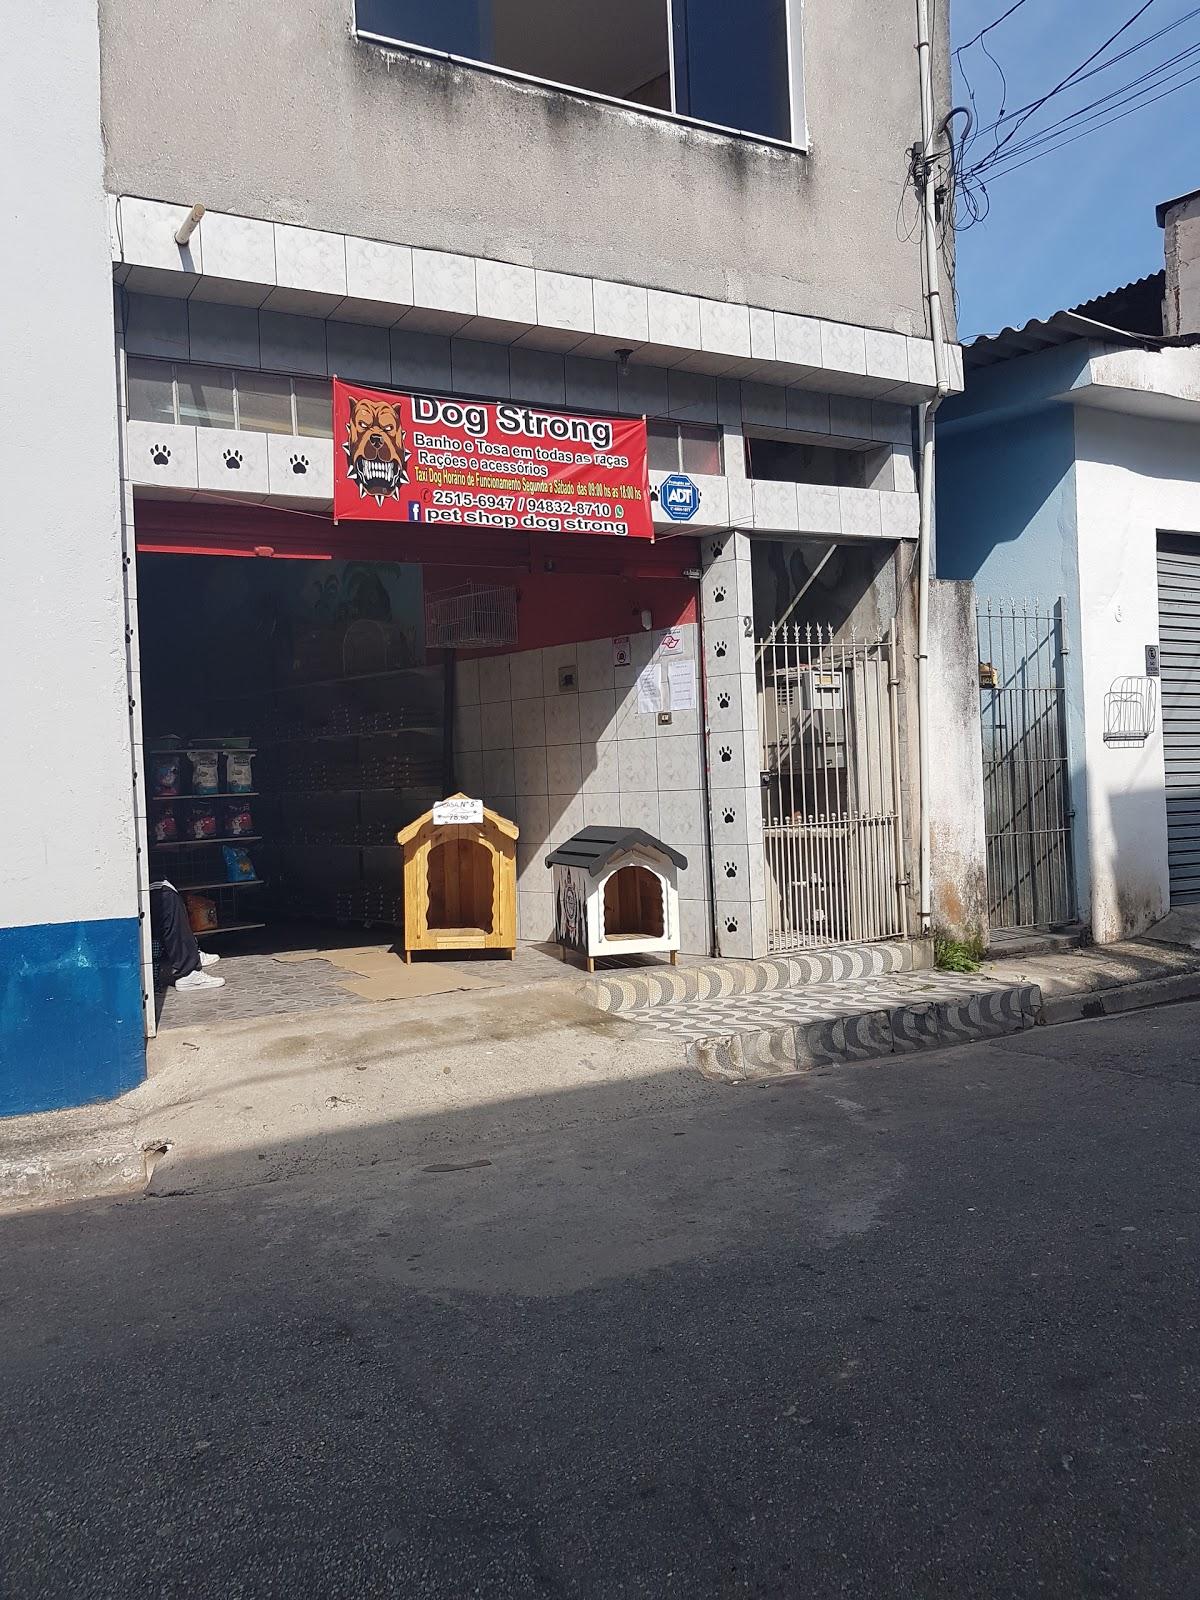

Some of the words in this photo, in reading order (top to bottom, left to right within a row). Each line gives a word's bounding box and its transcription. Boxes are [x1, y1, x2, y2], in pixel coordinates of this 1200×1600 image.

[412, 395, 487, 436] Dog
[498, 404, 612, 449] Strong
[415, 433, 461, 450] Banho
[465, 442, 473, 451] e
[477, 440, 508, 455] Tosa
[512, 447, 532, 458] em
[536, 448, 572, 462] todas
[576, 454, 591, 462] as
[595, 455, 628, 468] raças
[419, 451, 466, 468] Rações
[470, 460, 478, 468] e
[481, 460, 547, 475] acessórios
[415, 466, 427, 482] Taxi
[429, 469, 442, 486] Dog
[443, 470, 465, 485] Horário
[467, 474, 474, 486] de
[476, 474, 521, 490] Funcionamento
[522, 478, 547, 494] Segunda
[549, 485, 553, 493] a
[553, 480, 574, 495] Sábado
[577, 484, 587, 496] das
[603, 485, 611, 497] hs
[612, 489, 618, 497] as
[635, 488, 641, 500] hs
[669, 488, 691, 503] ADT
[434, 491, 513, 509] 2515-6947
[518, 499, 524, 510] /
[528, 499, 610, 516] 94832-8710
[427, 508, 461, 522] pet
[465, 511, 516, 528] shop
[523, 516, 560, 530] dog
[565, 517, 628, 534] strong
[743, 616, 753, 638] 2
